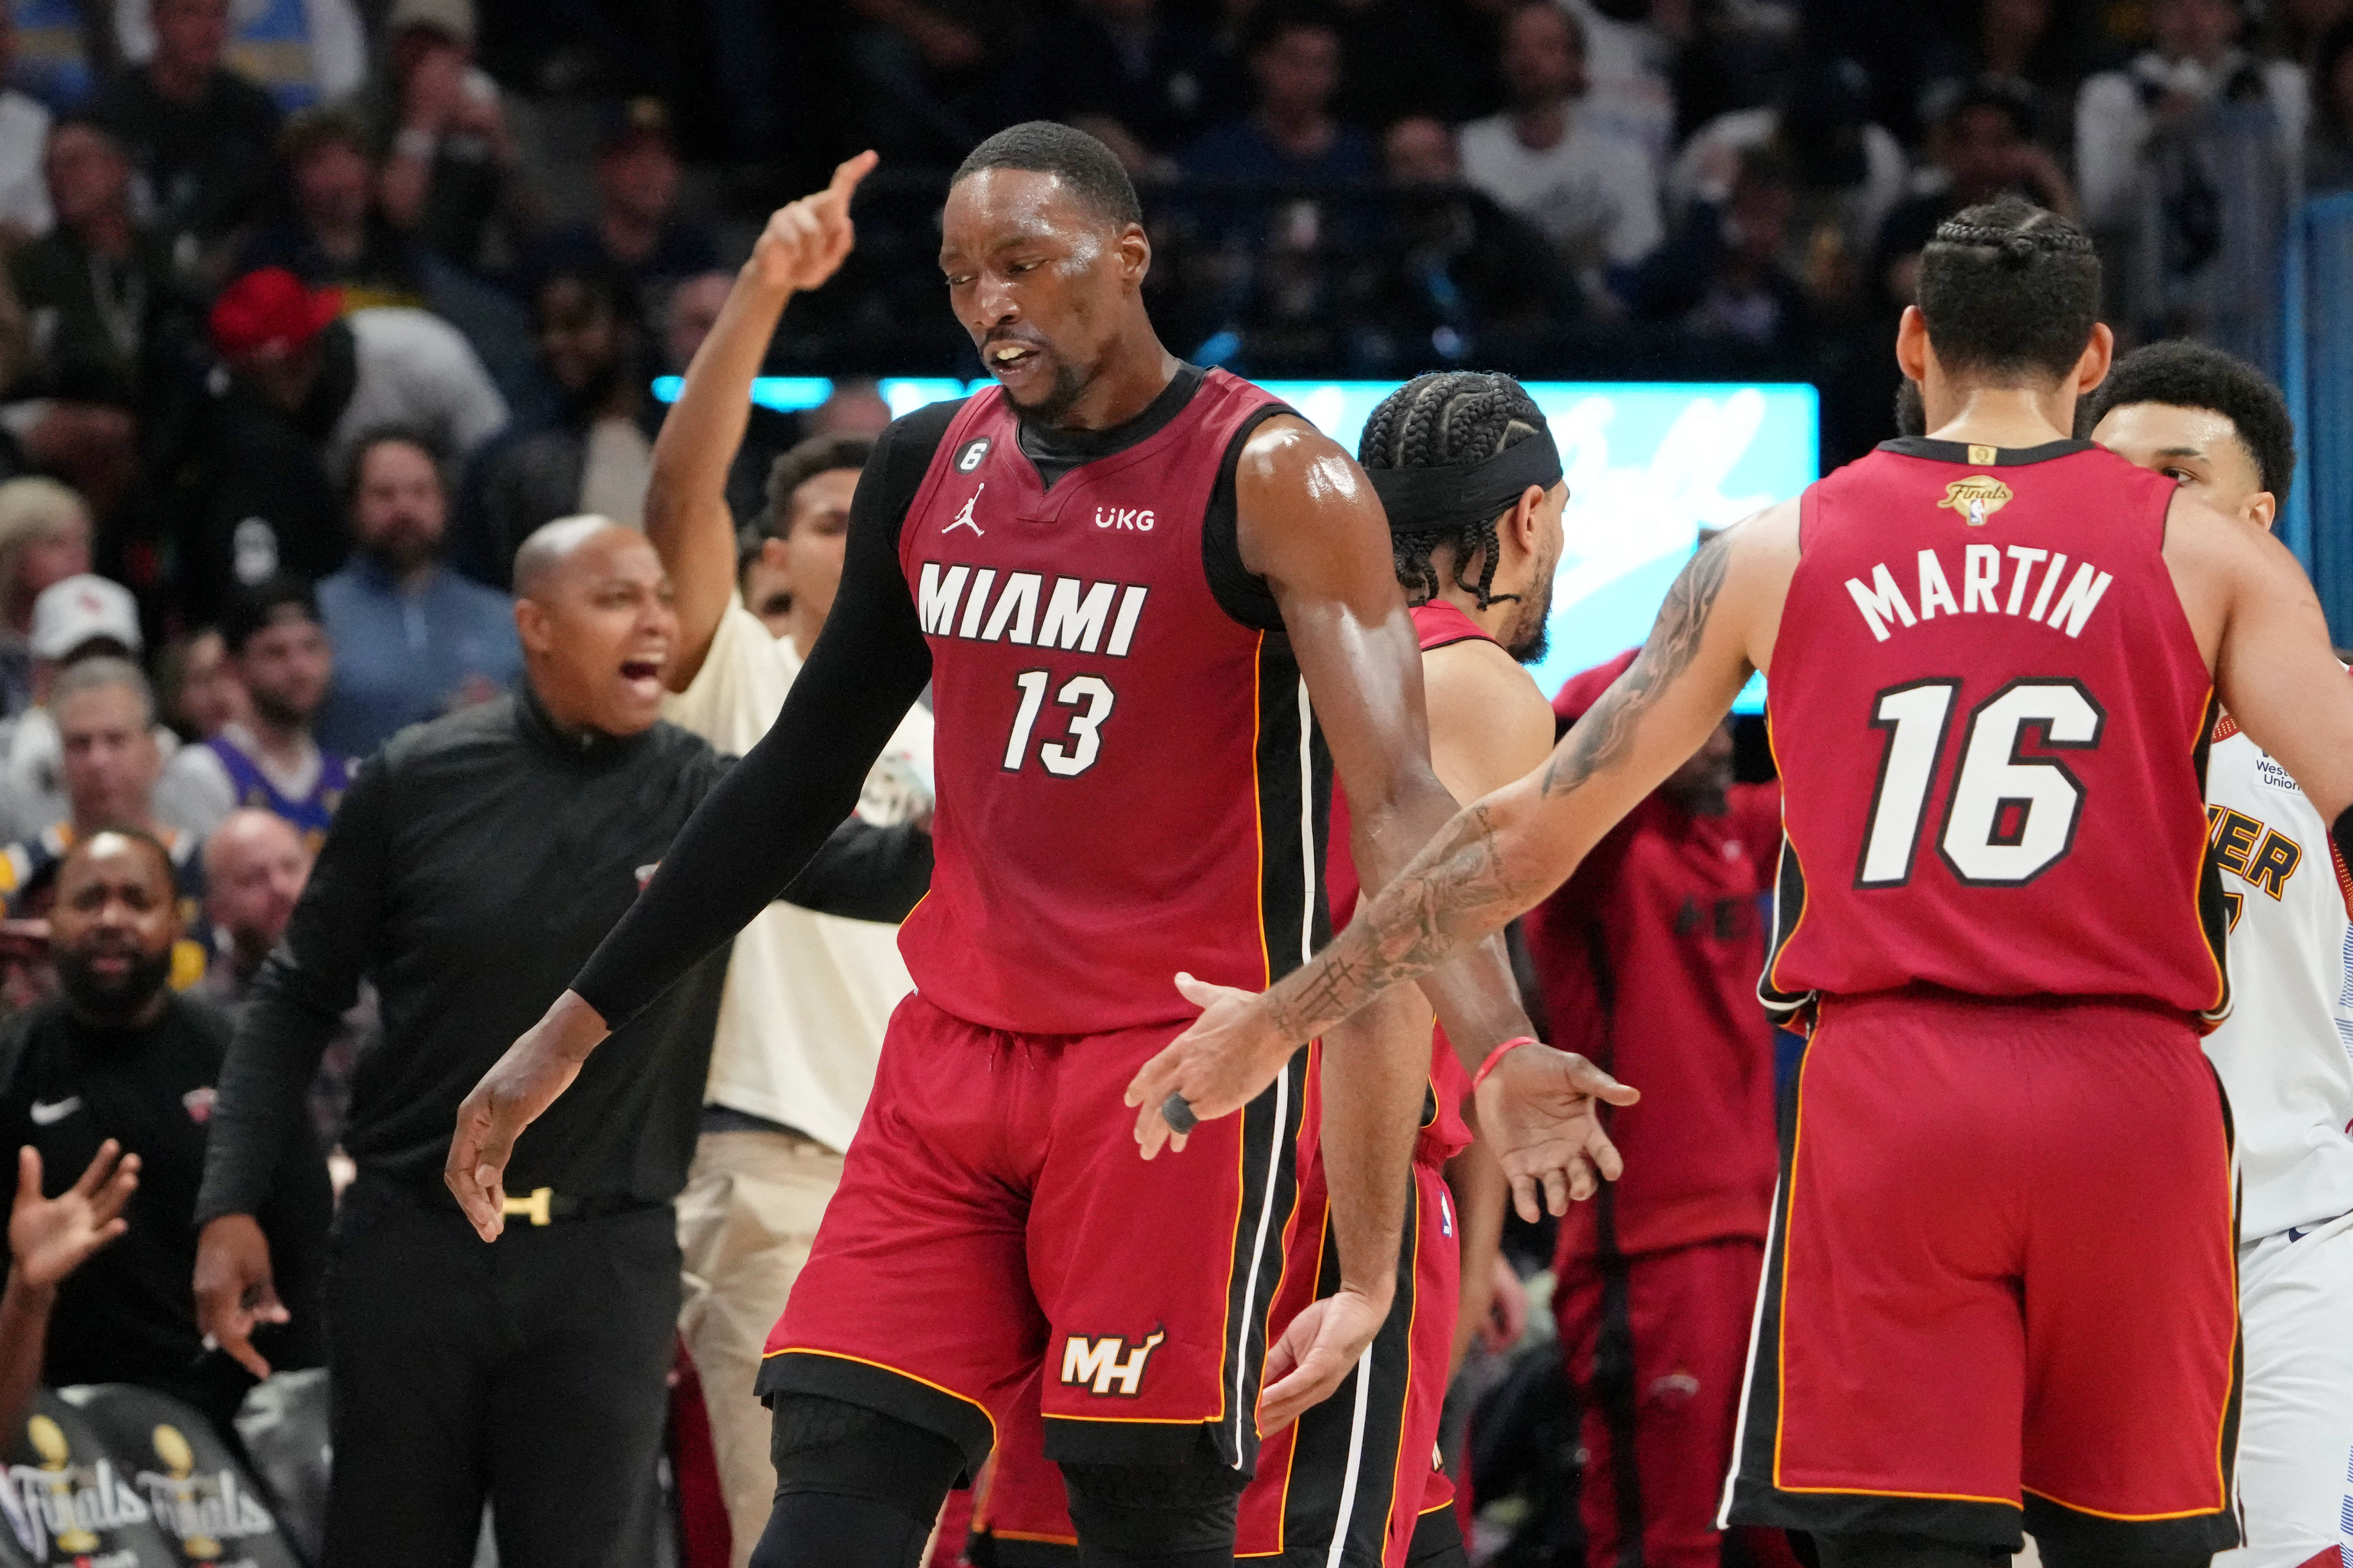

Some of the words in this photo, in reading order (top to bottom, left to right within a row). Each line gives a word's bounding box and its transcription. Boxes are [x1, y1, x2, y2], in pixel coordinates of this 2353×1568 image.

[960, 443, 987, 469] 6
[1941, 483, 2008, 505] Finals
[917, 561, 1149, 658] MIAMI
[1844, 543, 2113, 642] MARTIN
[1001, 669, 1115, 777] 13
[1855, 678, 2106, 888] 16
[2264, 773, 2300, 790] Union
